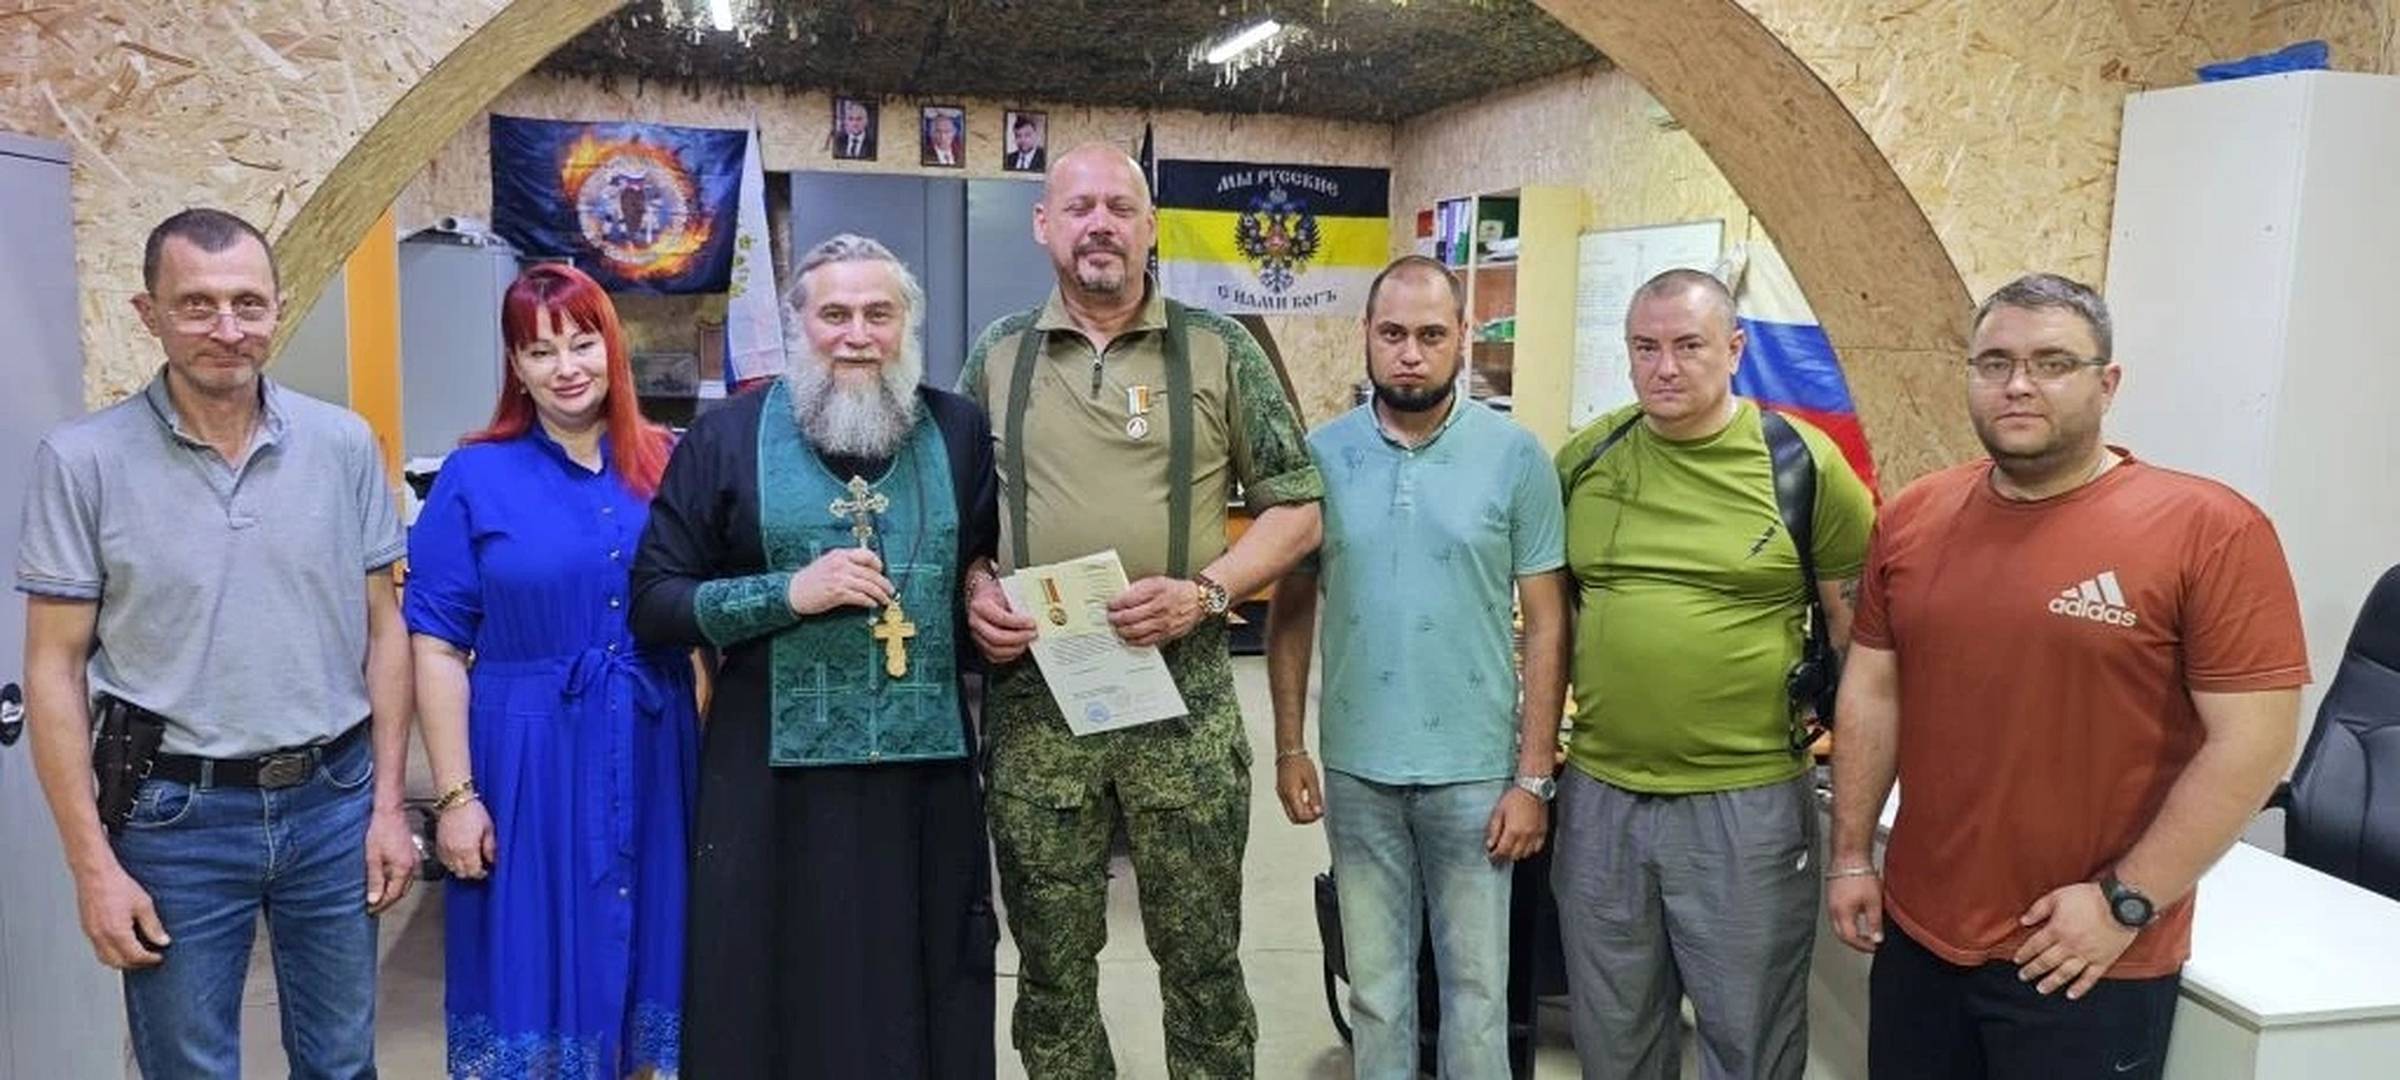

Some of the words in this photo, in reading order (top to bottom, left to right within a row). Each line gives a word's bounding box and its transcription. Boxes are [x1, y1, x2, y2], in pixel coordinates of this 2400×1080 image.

[1217, 171, 1252, 193] МЫ
[1257, 169, 1338, 197] РУССКИЕ
[1234, 289, 1287, 310] НАМИ
[2048, 597, 2137, 627] adidas
